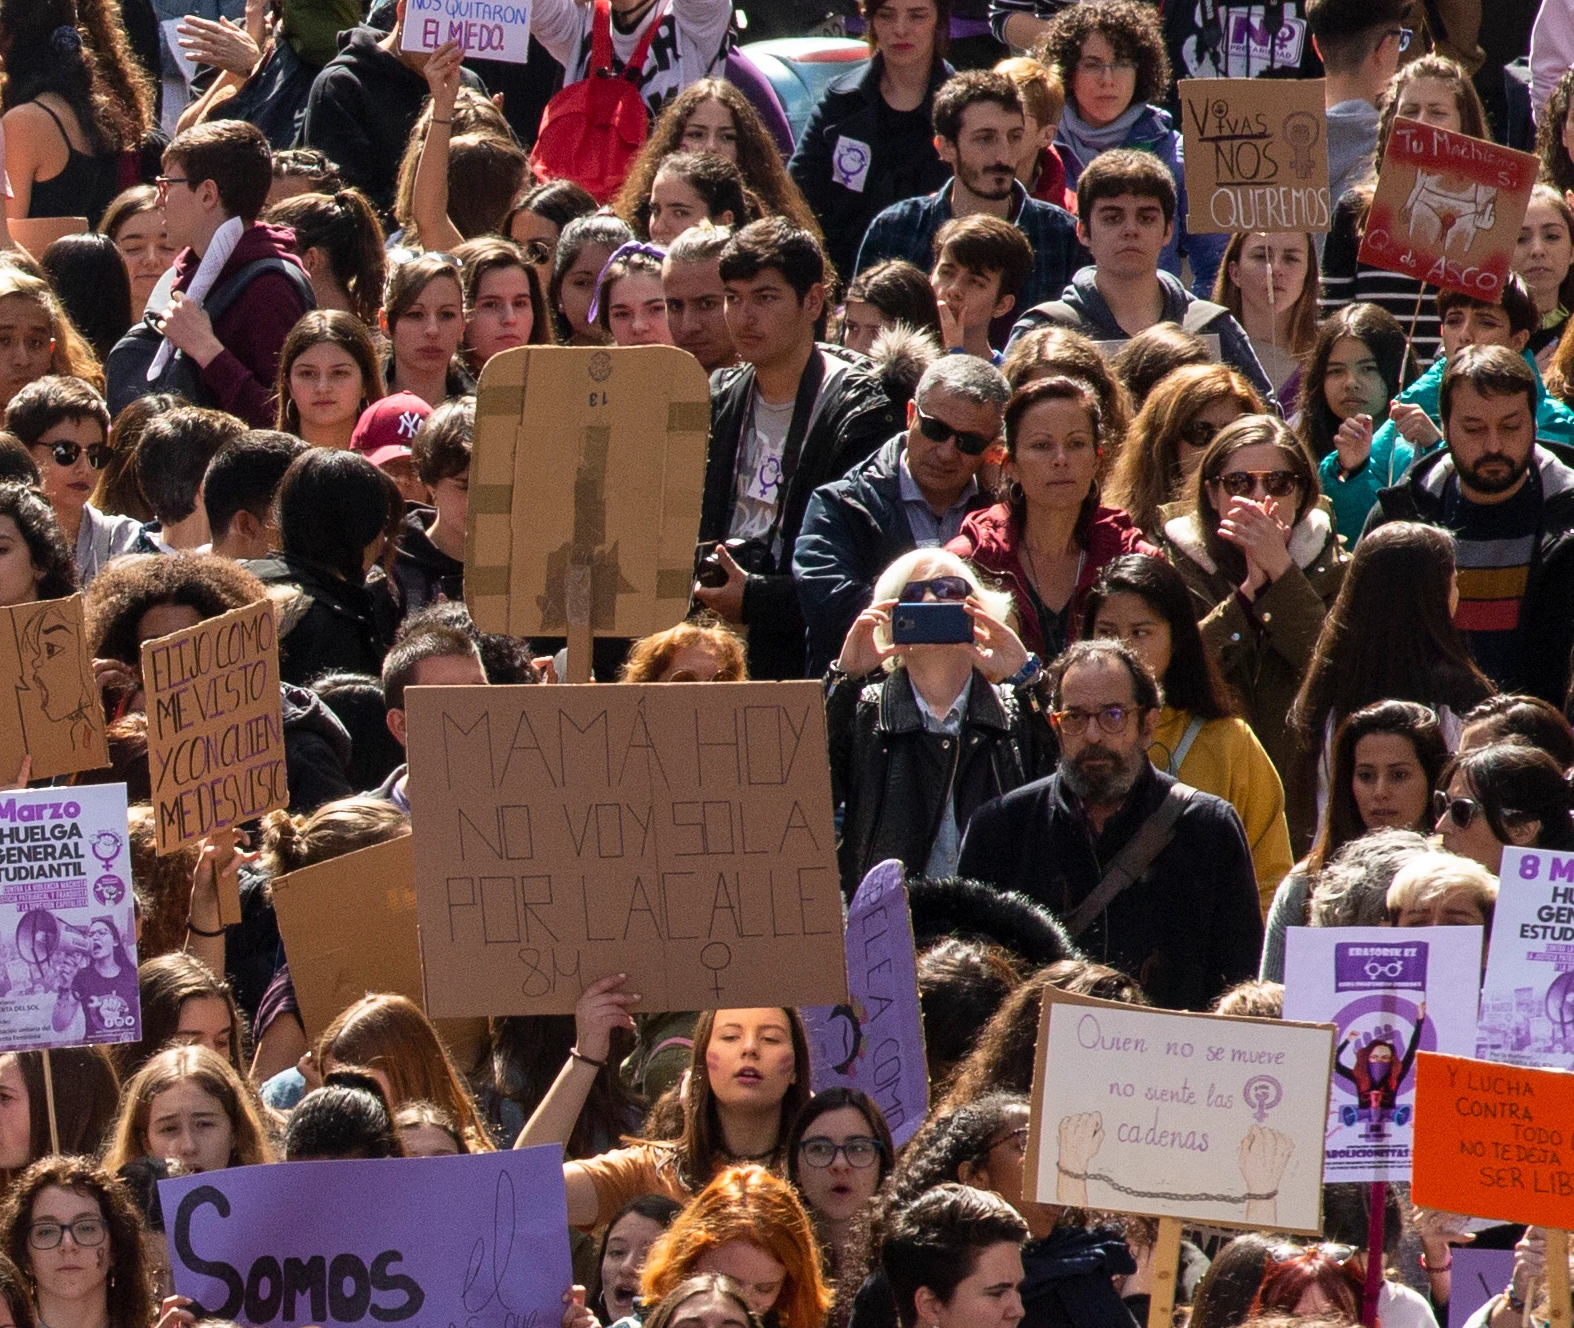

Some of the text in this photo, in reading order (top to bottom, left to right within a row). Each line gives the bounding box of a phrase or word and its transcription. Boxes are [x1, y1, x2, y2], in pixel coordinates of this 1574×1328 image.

[445, 0, 527, 25] QUITARON
[422, 18, 441, 48] EL
[1215, 142, 1279, 180] NOS
[1210, 186, 1331, 230] QUEREMOS
[442, 696, 812, 792] MAMÁ HOY
[458, 801, 822, 861] NO VOY SOLA
[1518, 854, 1541, 880] 8
[1456, 1097, 1533, 1122] CONTRA
[1117, 1107, 1209, 1153] cadenas
[1511, 1123, 1563, 1146] TODO
[1459, 1141, 1561, 1166] NO TE DEJA
